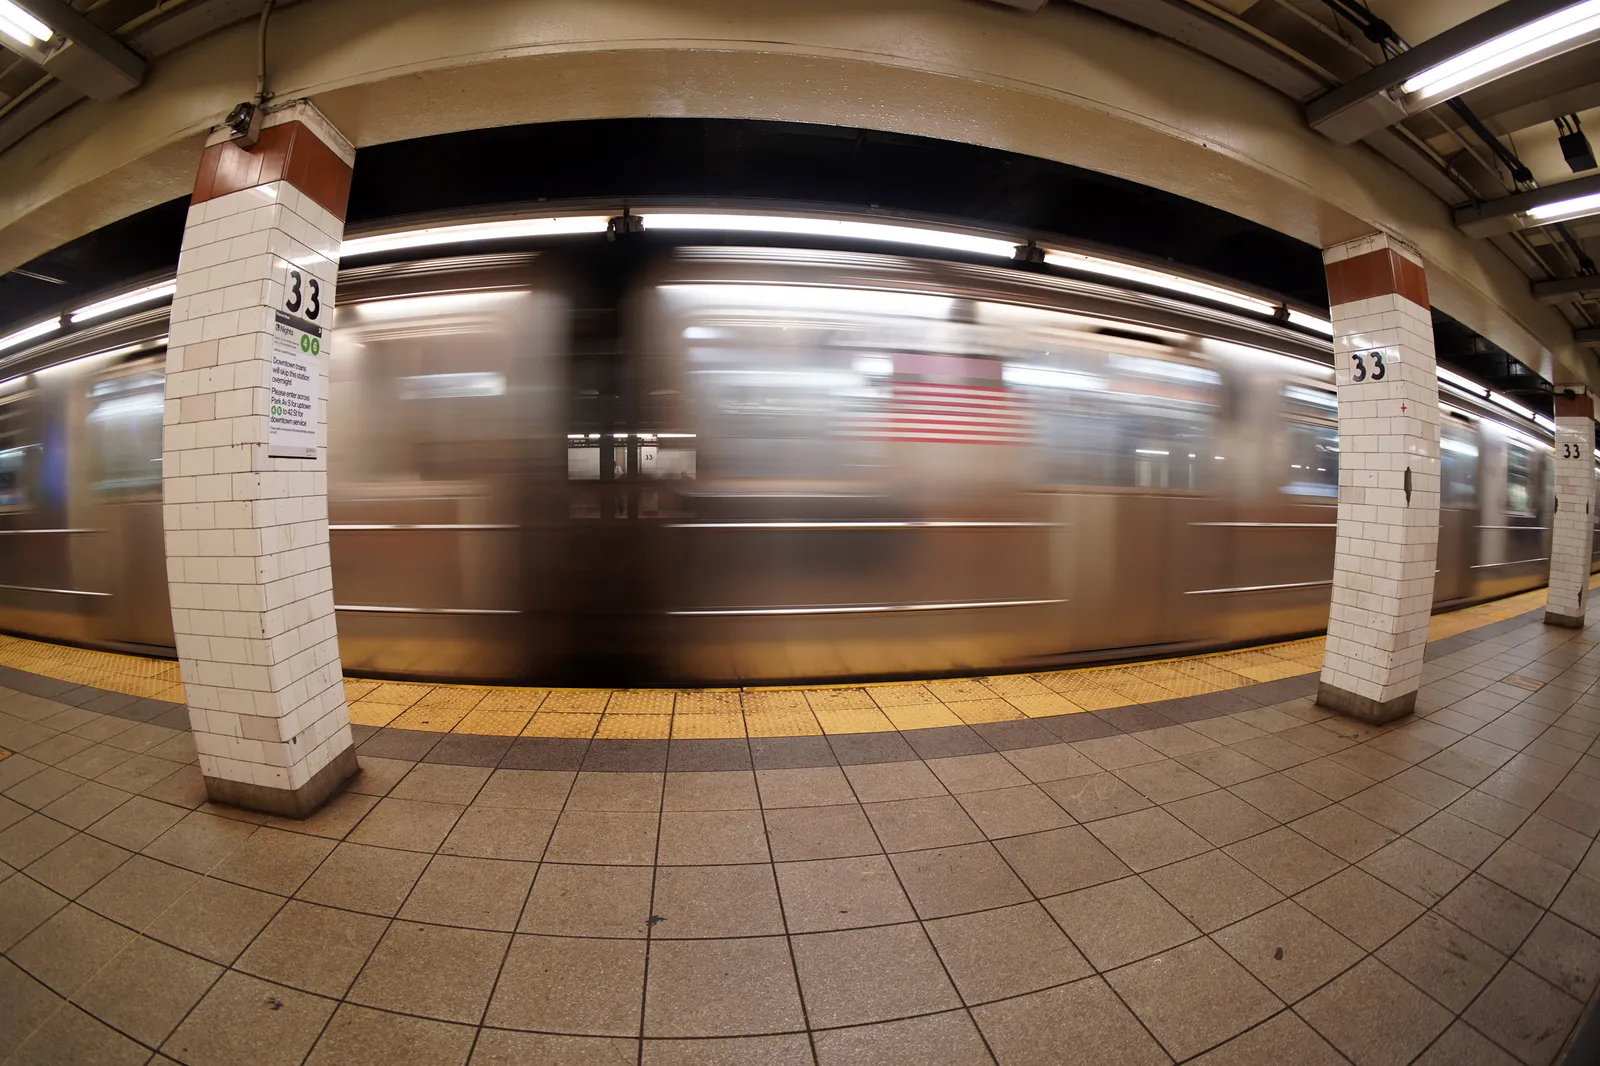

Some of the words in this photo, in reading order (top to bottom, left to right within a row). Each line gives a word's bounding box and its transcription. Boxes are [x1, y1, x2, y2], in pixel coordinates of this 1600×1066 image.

[286, 270, 320, 320] 33
[280, 325, 294, 336] Nights
[273, 356, 295, 368] Downtown
[296, 364, 306, 372] trains
[1352, 351, 1386, 382] 33
[272, 376, 292, 386] overnight
[280, 368, 289, 377] skip
[297, 373, 310, 381] station
[272, 387, 286, 397] Please
[270, 416, 292, 424] downtown
[1564, 444, 1580, 459] 33
